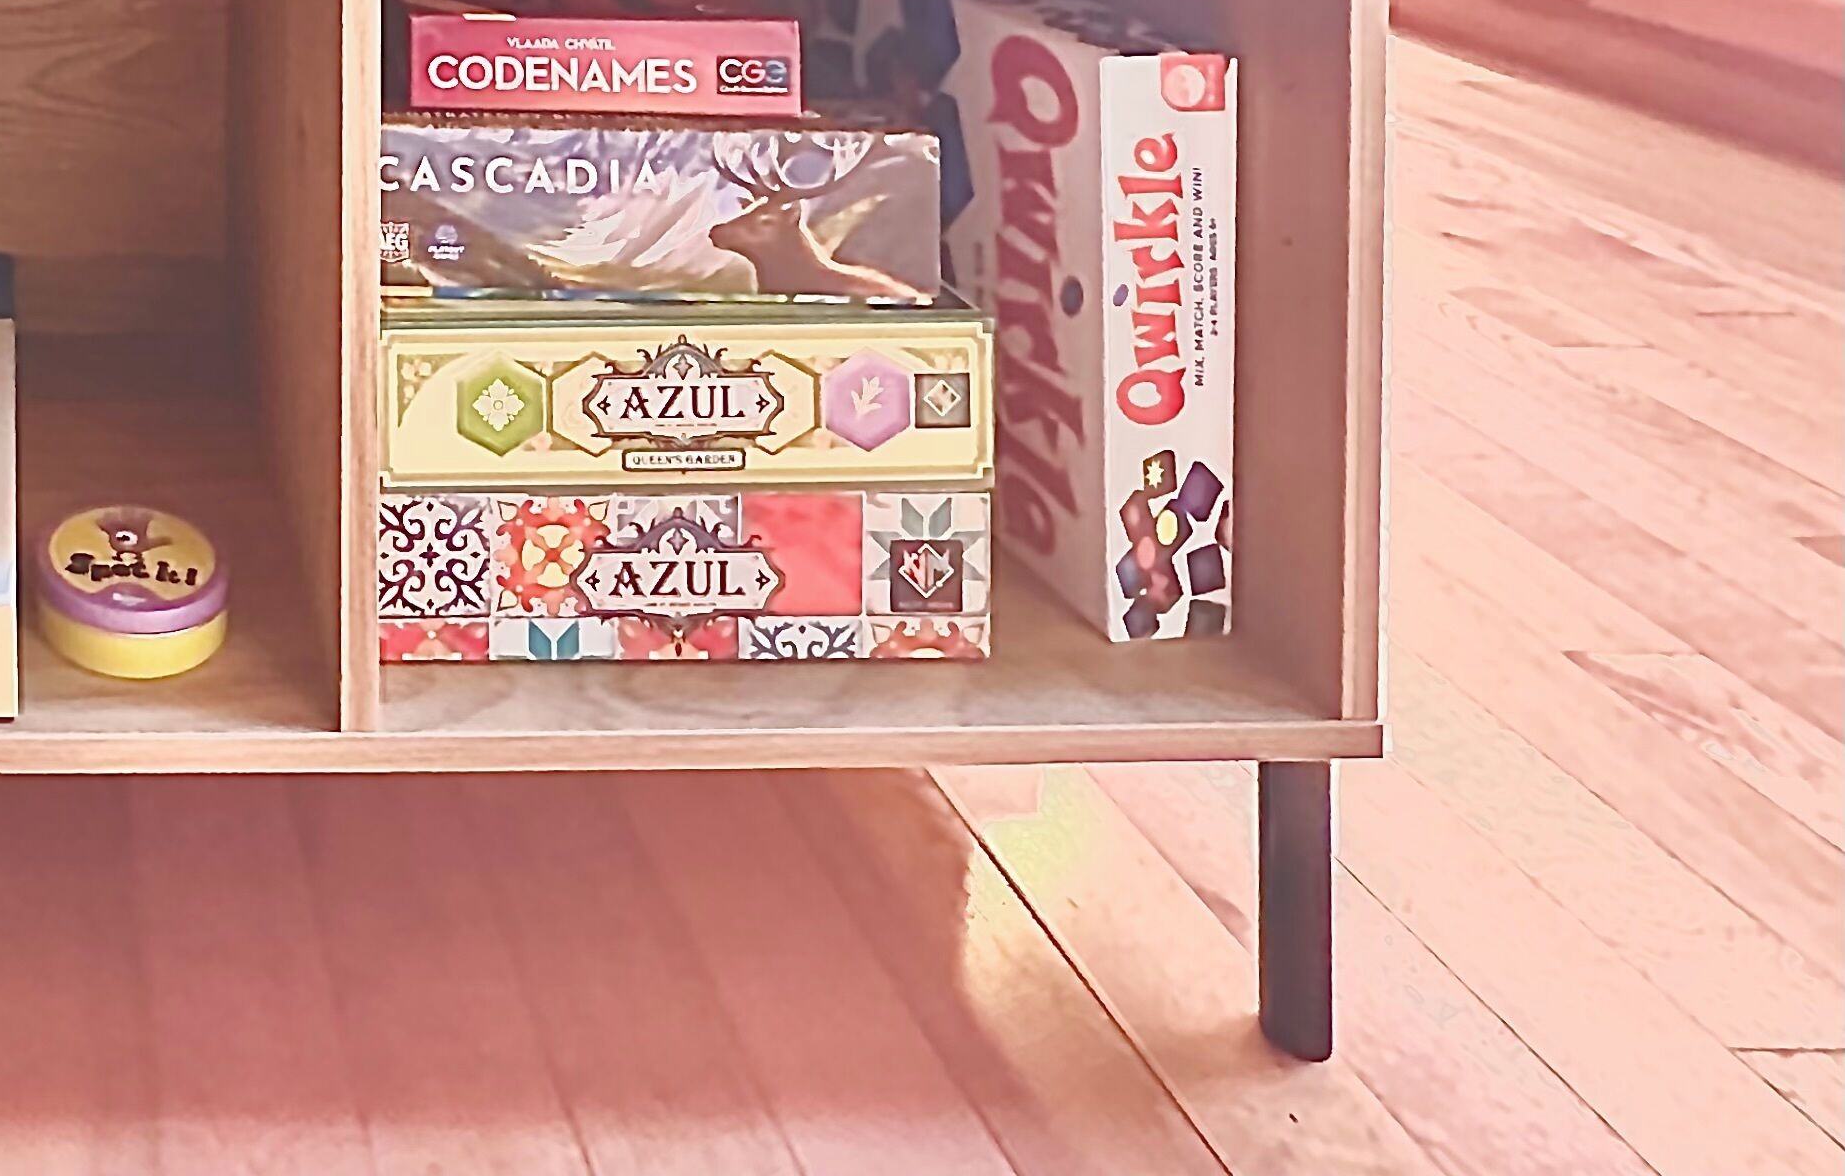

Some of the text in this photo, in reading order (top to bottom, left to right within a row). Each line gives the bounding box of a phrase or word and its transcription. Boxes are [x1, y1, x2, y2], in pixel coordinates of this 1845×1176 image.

[428, 54, 698, 94] CODENAMES
[379, 156, 659, 194] CASCADIA
[1191, 167, 1204, 203] WIN!
[1192, 206, 1204, 242] AND
[1113, 130, 1188, 426] Qwirkle
[1192, 248, 1205, 294] SCORE
[620, 385, 747, 420] AZUL
[609, 560, 747, 597] AZUL
